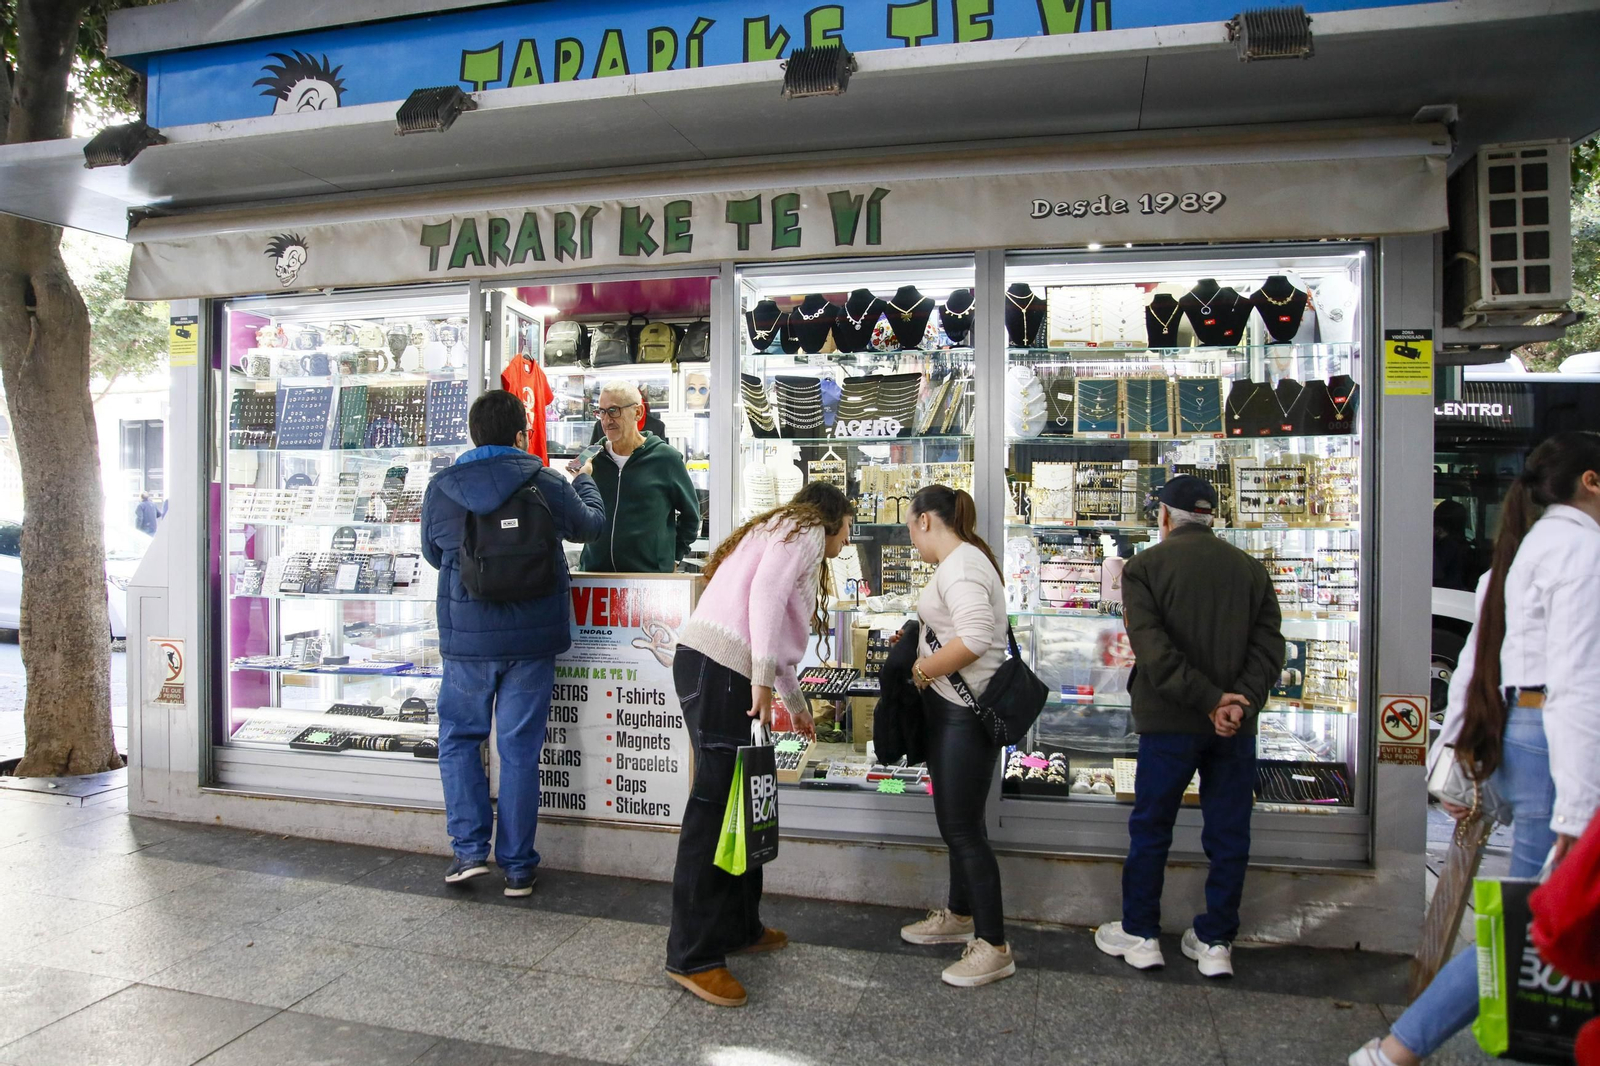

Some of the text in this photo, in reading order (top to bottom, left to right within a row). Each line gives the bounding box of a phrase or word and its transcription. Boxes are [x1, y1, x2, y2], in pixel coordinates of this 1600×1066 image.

[459, 16, 717, 92] TARARÍ
[886, 0, 994, 48] TE
[1030, 191, 1226, 219] Desde 1989
[420, 187, 891, 271] TARARÍ KE TE VÍ
[834, 419, 901, 438] ACERO
[592, 667, 606, 679] KE
[610, 668, 623, 680] TE
[616, 687, 666, 706] T-shirts
[616, 709, 683, 730] Keychains
[616, 731, 670, 751] Magnets
[616, 753, 678, 773] Bracelets
[616, 775, 647, 795] Caps
[616, 797, 670, 817] Stickers
